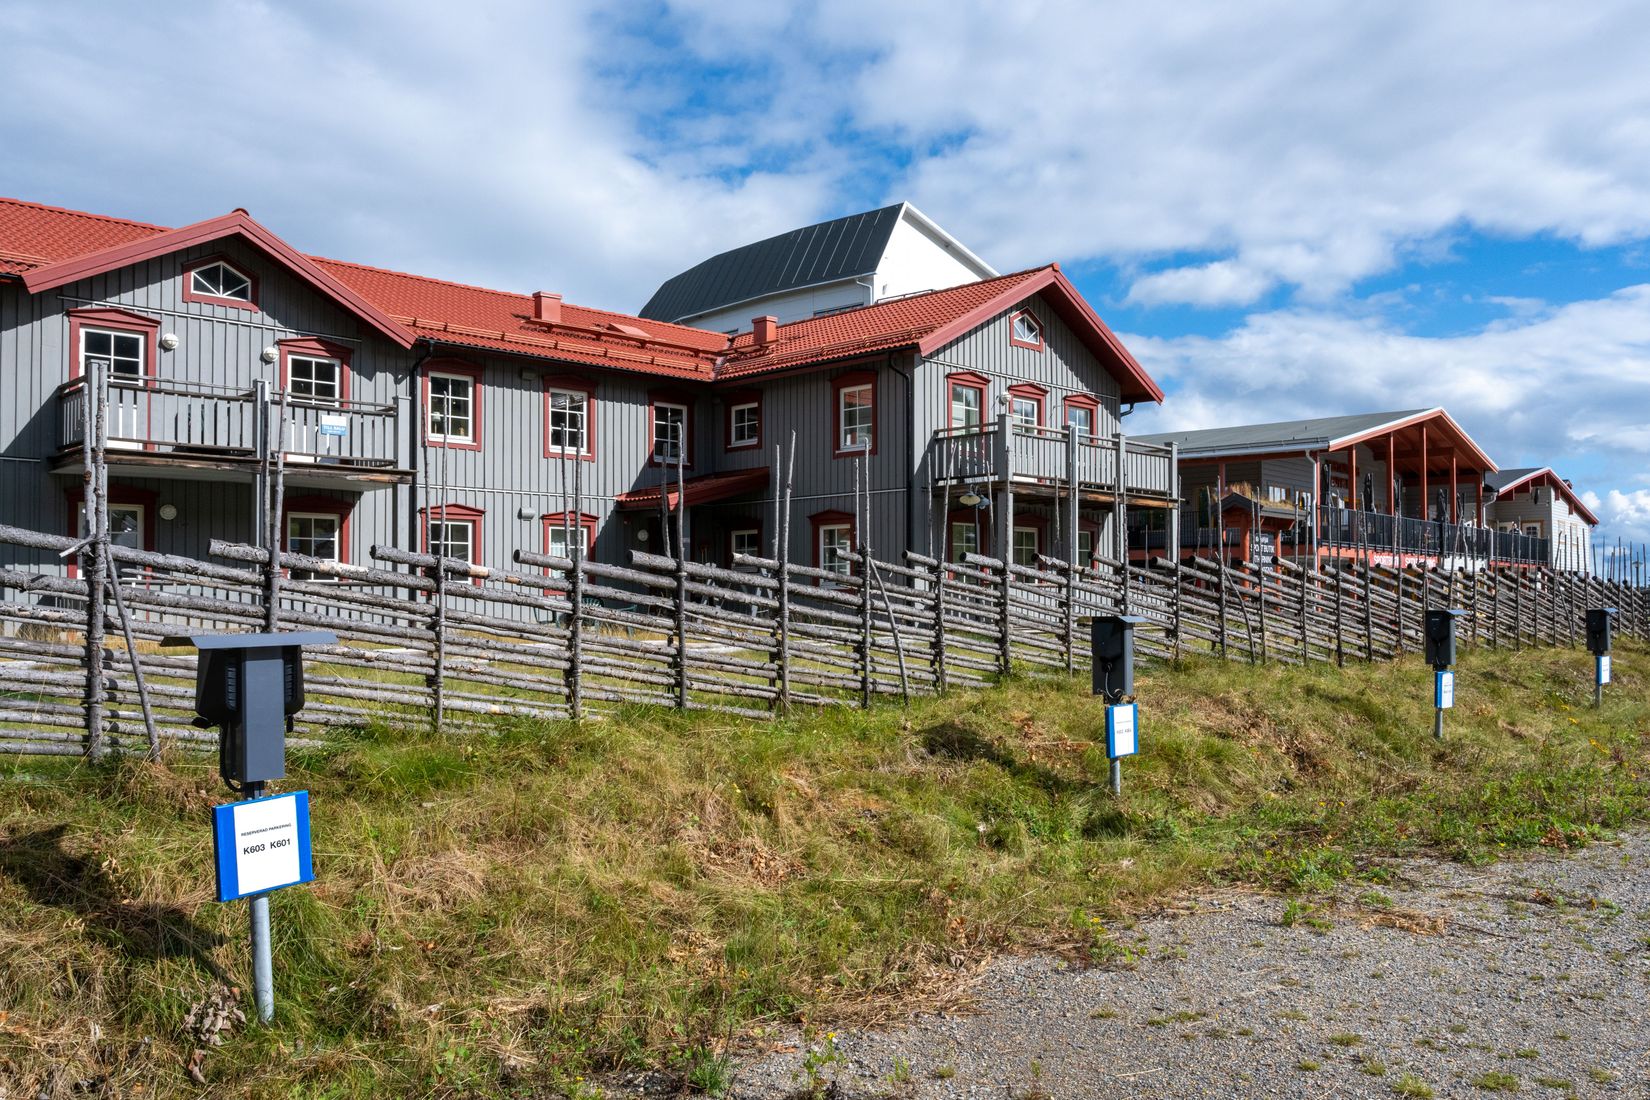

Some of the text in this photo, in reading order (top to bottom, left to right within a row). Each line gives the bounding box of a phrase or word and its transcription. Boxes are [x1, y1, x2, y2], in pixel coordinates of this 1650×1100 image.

[241, 828, 268, 836] RESERVERAD
[243, 838, 291, 855] K603 K601
